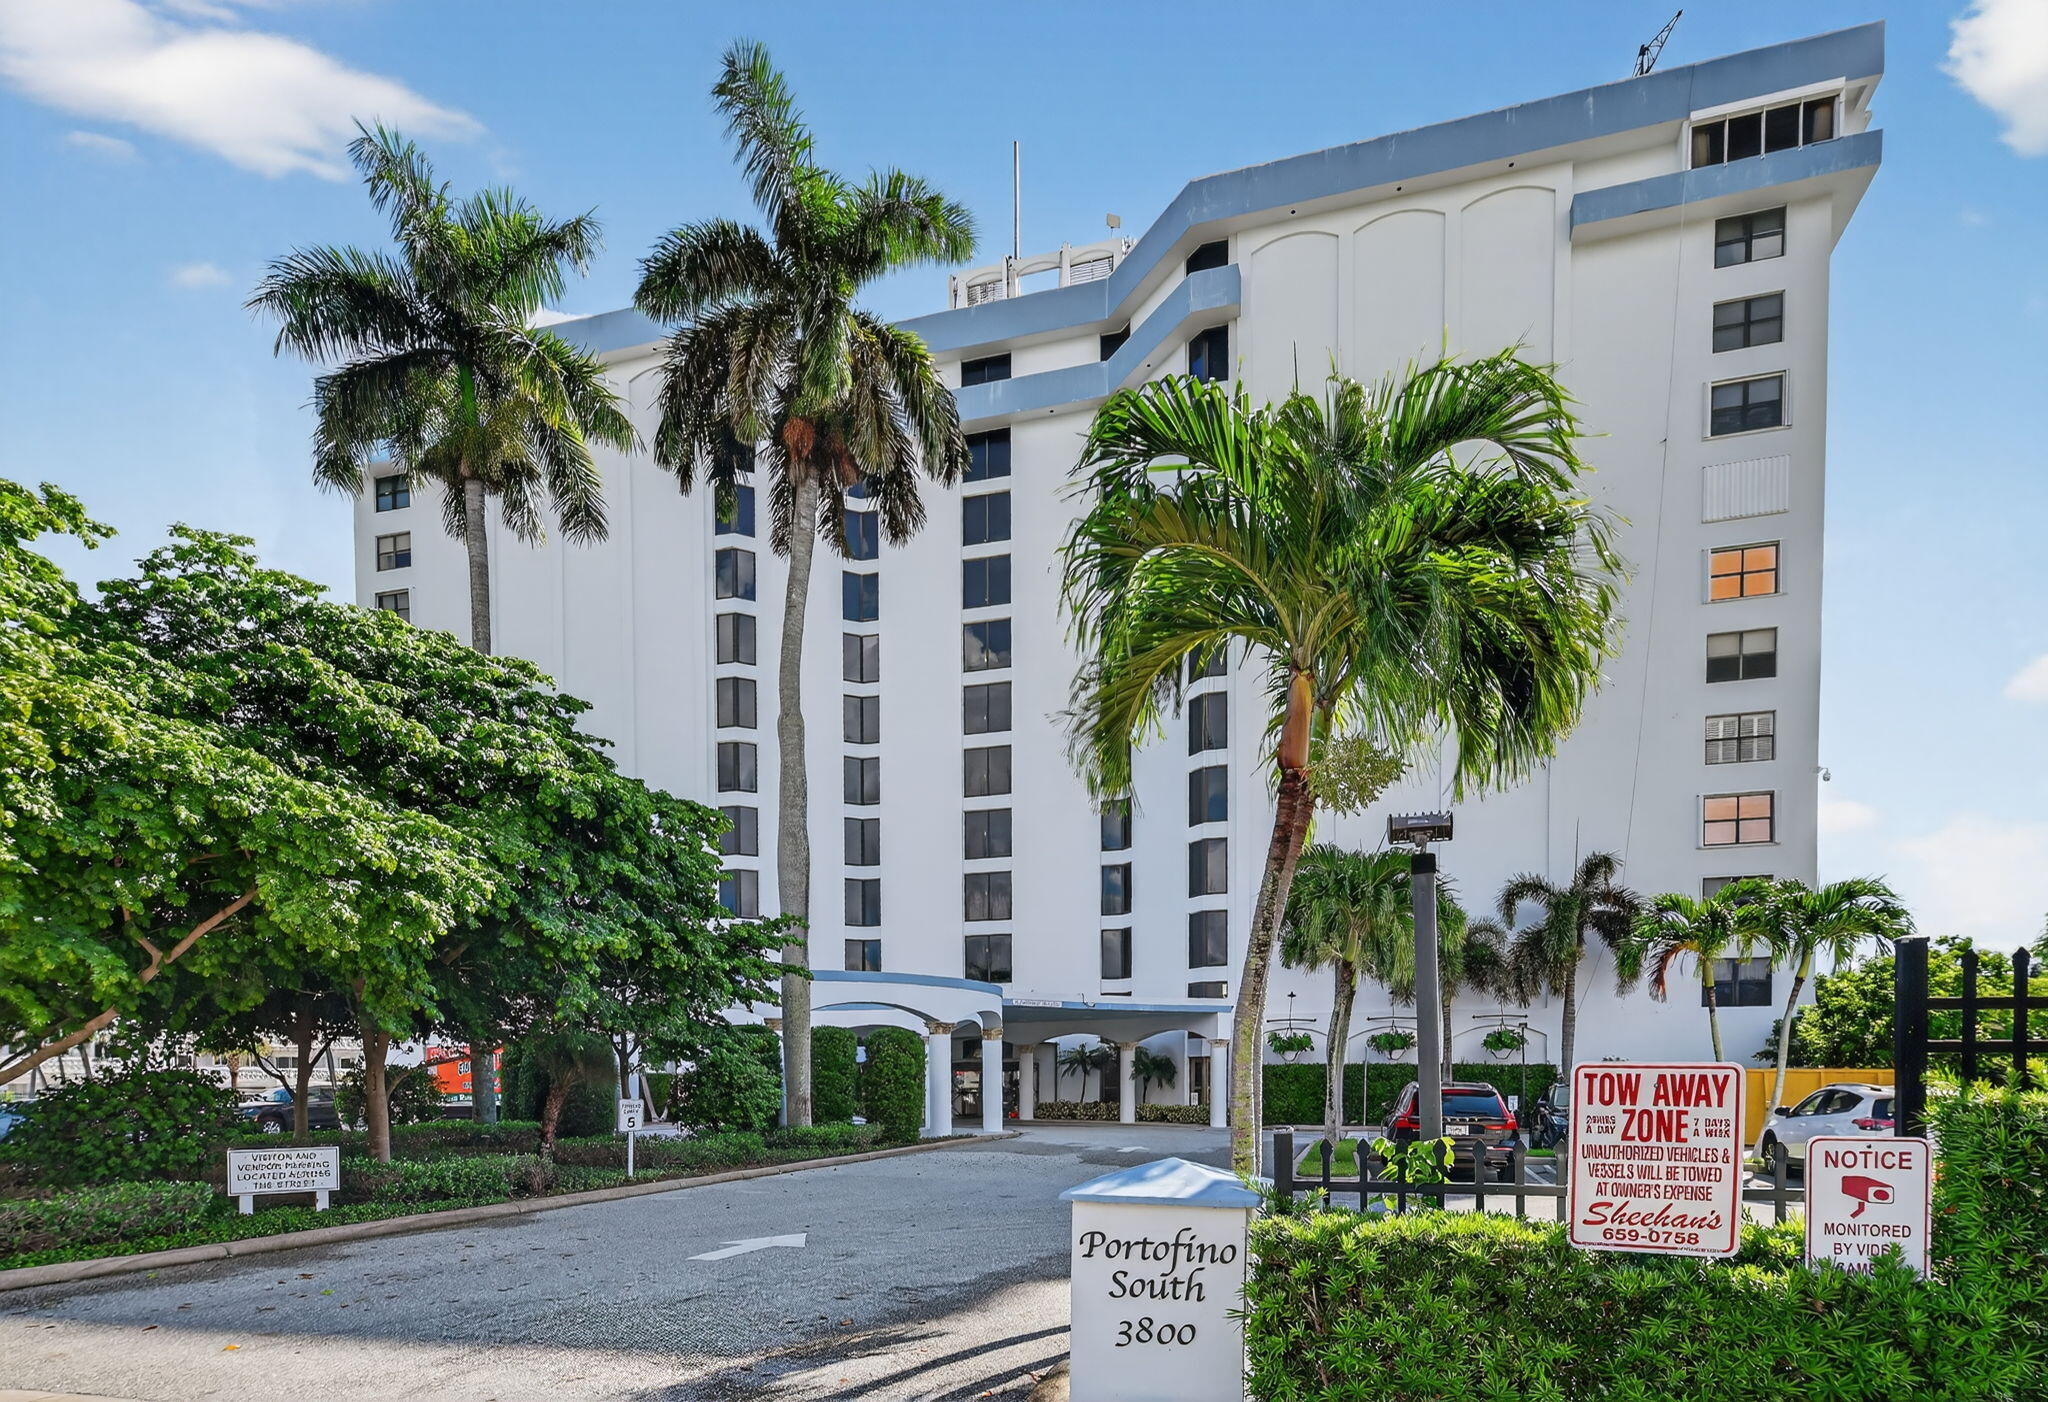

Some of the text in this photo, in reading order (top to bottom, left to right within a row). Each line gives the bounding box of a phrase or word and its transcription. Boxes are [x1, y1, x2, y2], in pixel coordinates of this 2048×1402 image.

[1584, 1073, 1730, 1108] TOW AWAY
[627, 1116, 635, 1128] 5
[1586, 1125, 1616, 1134] A DAY
[1621, 1109, 1689, 1143] ZONE
[1693, 1118, 1731, 1128] 7 DAYS
[1693, 1128, 1700, 1137] A
[1582, 1144, 1731, 1164] UNAUTHORIZED VEHICLES &
[1824, 1150, 1913, 1170] NOTICE
[1588, 1162, 1722, 1183] VESSELS WILL BE TOWED
[1596, 1182, 1713, 1201] AT OWNER'S EXPENSE
[1583, 1200, 1722, 1230] Sheehan's
[1603, 1228, 1700, 1245] 659-0758
[1824, 1222, 1912, 1238] MONITORED
[1079, 1227, 1237, 1277] Portofino
[1833, 1242, 1891, 1257] BY VIDE
[1108, 1267, 1206, 1303] South
[1115, 1316, 1197, 1347] 3800
